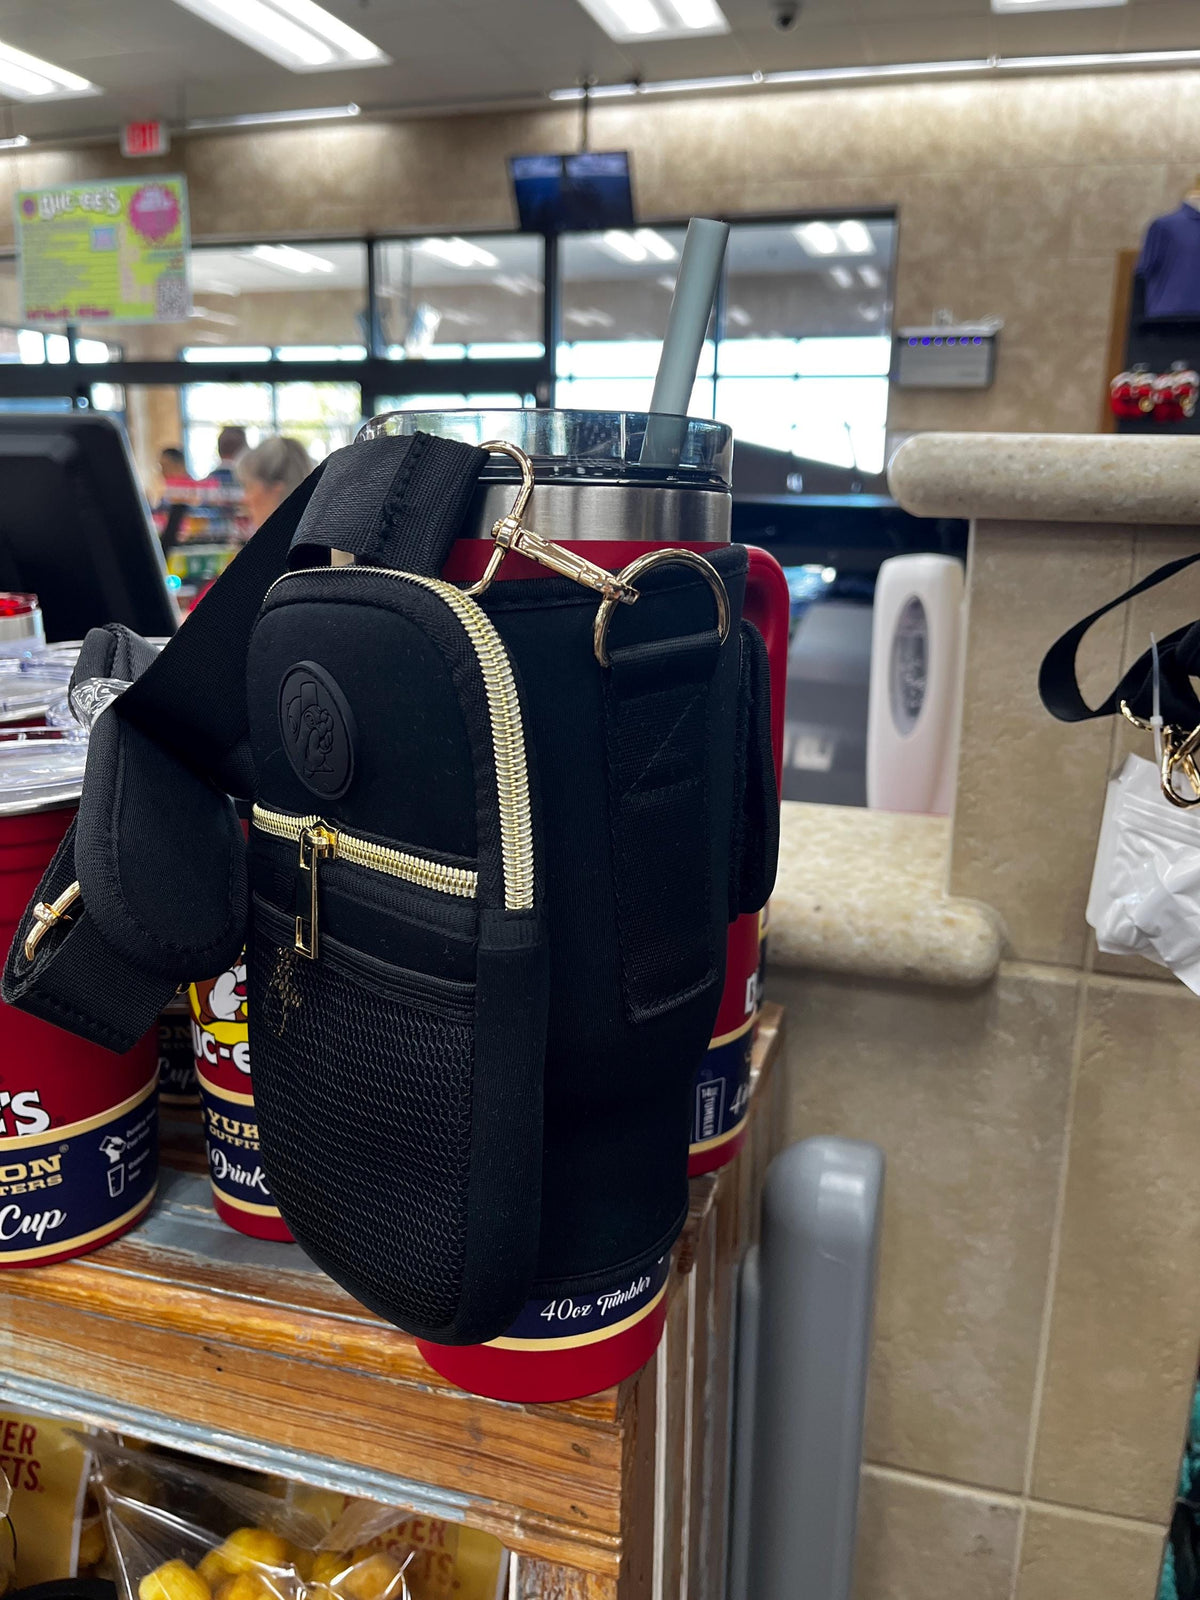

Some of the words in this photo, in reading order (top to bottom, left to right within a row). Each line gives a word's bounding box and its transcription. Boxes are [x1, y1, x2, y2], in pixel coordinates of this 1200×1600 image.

[211, 1148, 270, 1195] Drink
[0, 1204, 67, 1241] Cup
[540, 1298, 593, 1321] 40oz
[597, 1276, 651, 1316] Tumbler
[0, 1420, 37, 1455] ER
